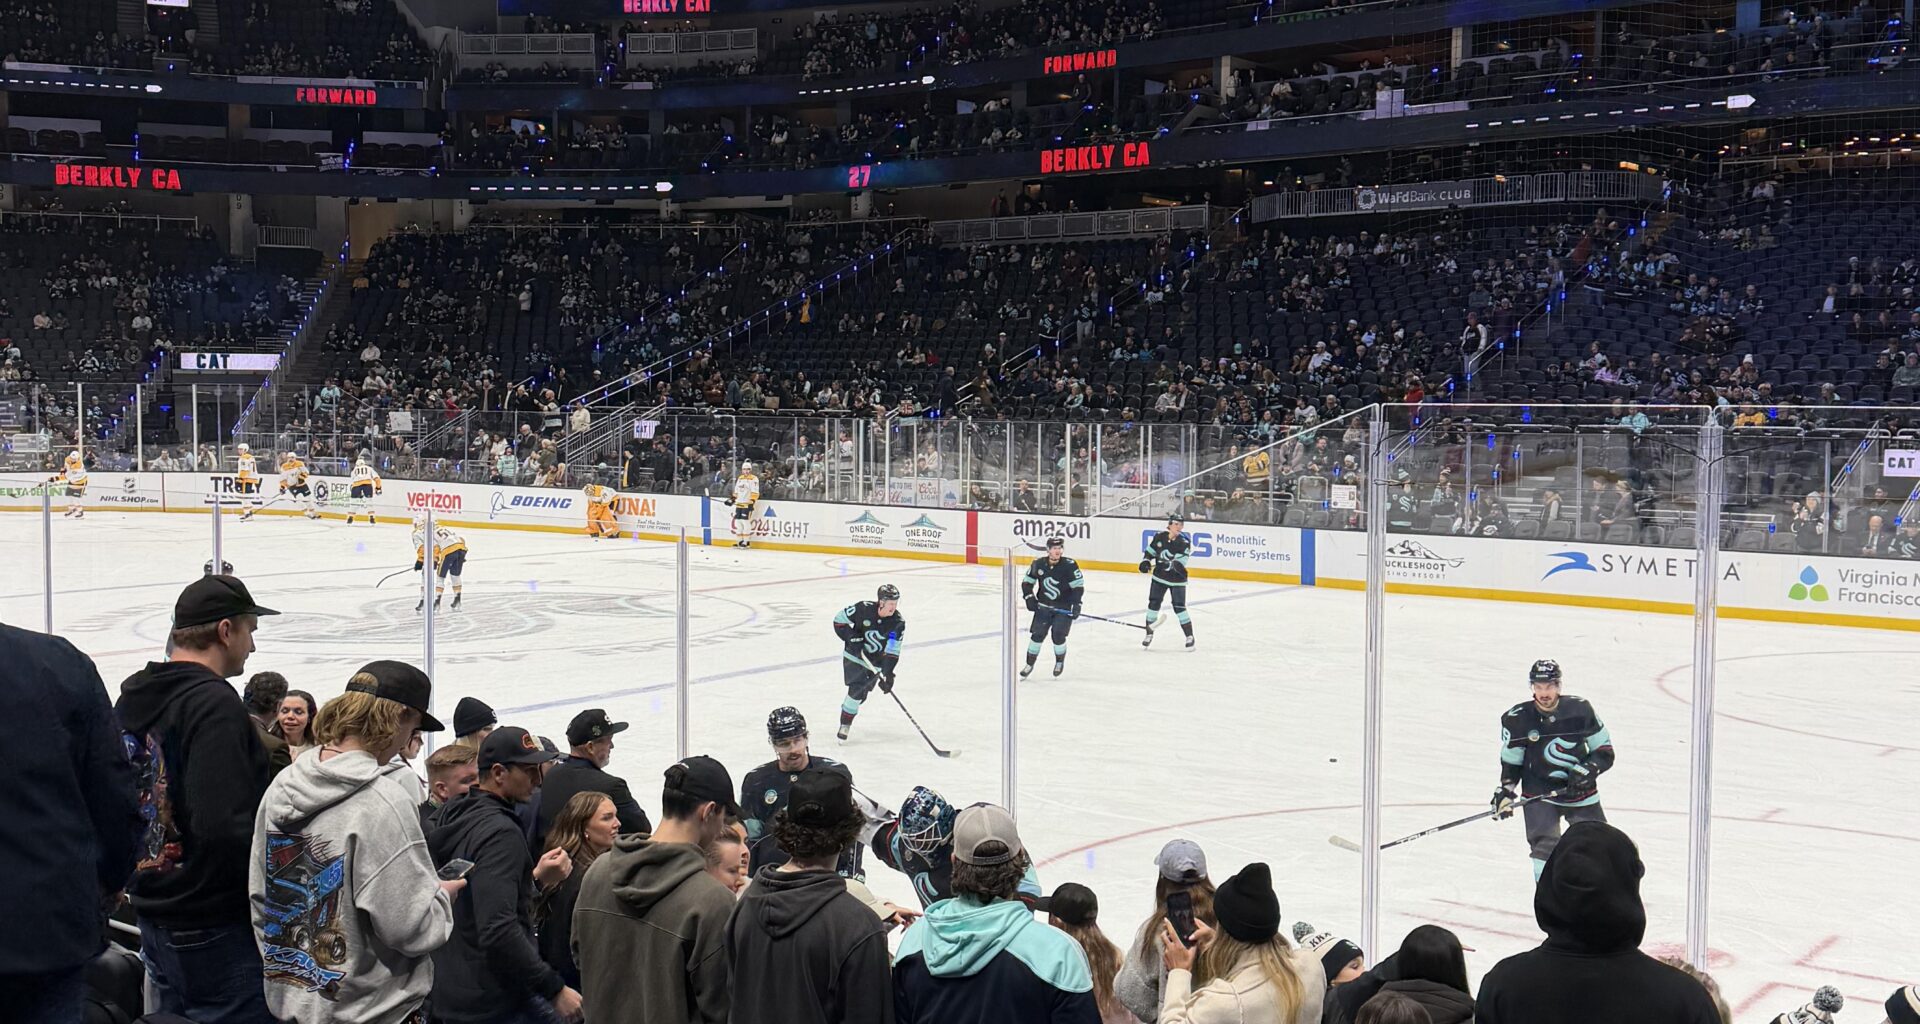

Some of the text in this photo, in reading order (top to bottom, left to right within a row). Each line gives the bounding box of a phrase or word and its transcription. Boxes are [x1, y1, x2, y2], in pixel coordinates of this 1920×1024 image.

[623, 0, 679, 13] BERKLY
[1043, 49, 1117, 75] FORWARD
[296, 87, 376, 105] FORWARD
[1041, 142, 1150, 174] BERKLY CA
[55, 163, 181, 190] BERKLY CA
[848, 165, 871, 188] 27
[1439, 189, 1471, 201] CLUB
[196, 353, 230, 369] CAT
[1888, 457, 1915, 469] CAT
[407, 489, 462, 511] verizon
[510, 495, 573, 509] BOEING
[616, 498, 656, 517] UNA!
[773, 520, 810, 537] LIGHT
[849, 525, 885, 535] ONE ROOF
[905, 529, 942, 539] ONE ROOF
[1013, 518, 1091, 539] amazon
[1216, 534, 1267, 546] Monolithic
[1216, 549, 1291, 562] Power Systems
[1385, 560, 1446, 572] UCKLESHOOT
[1602, 553, 1741, 581] SYMETA
[1838, 568, 1907, 588] Virginia
